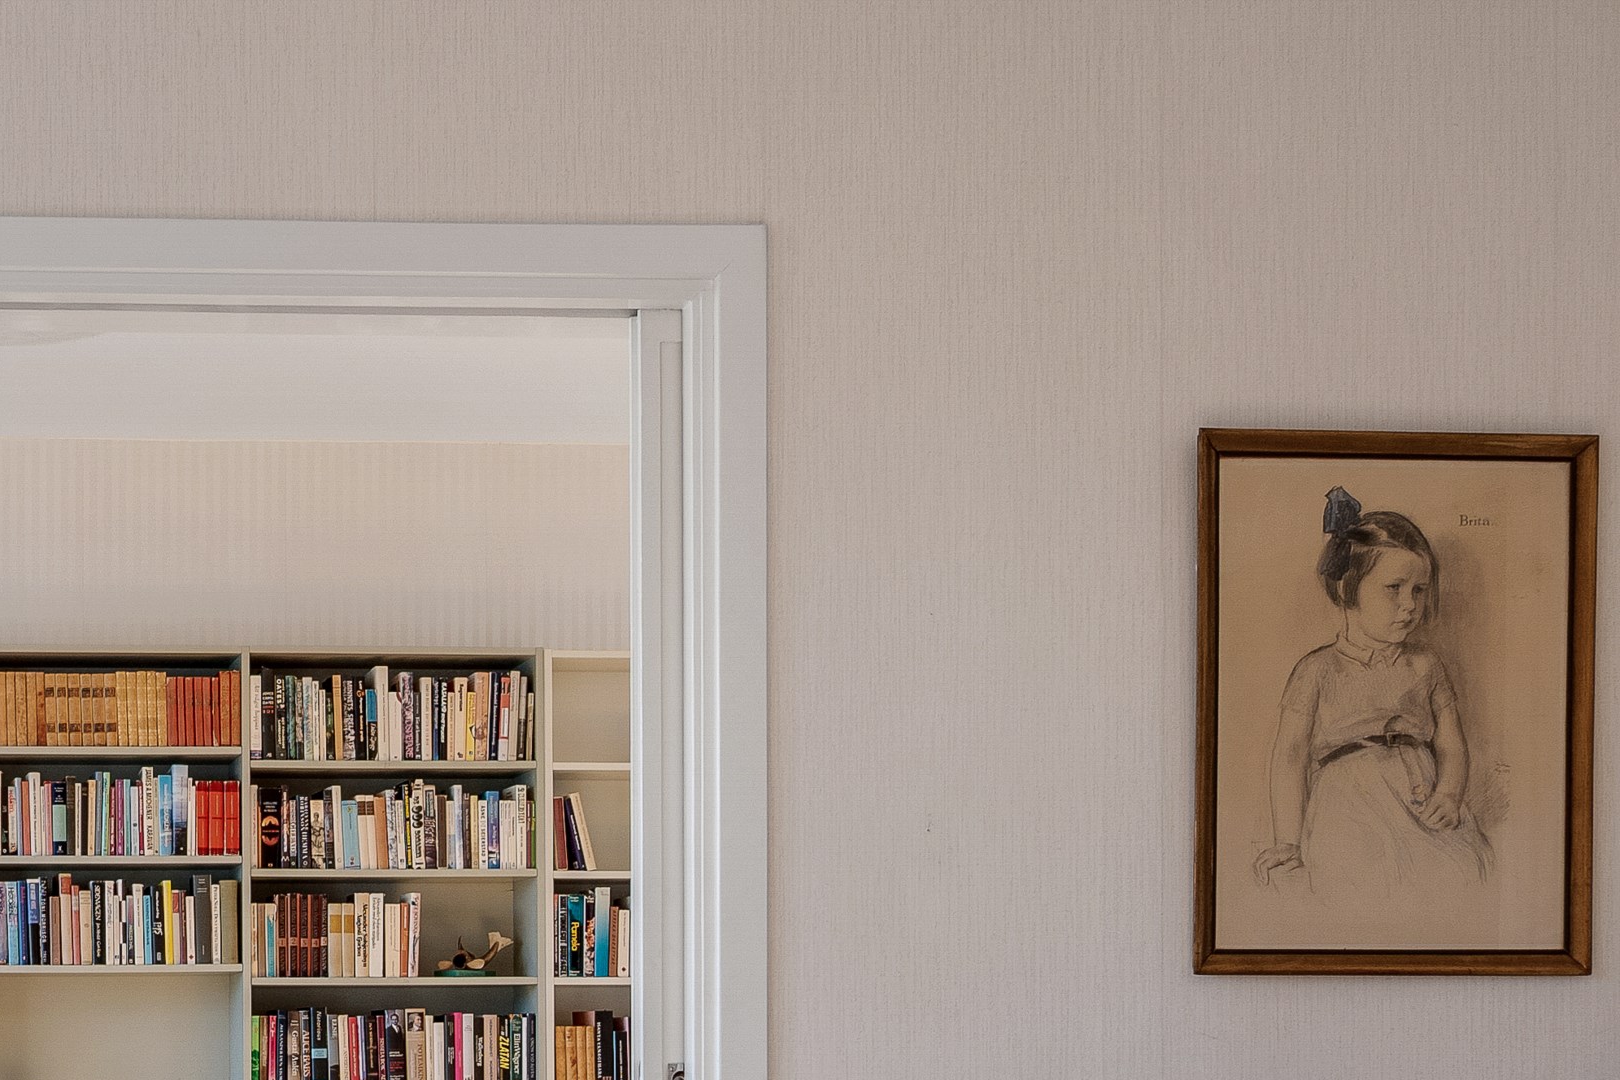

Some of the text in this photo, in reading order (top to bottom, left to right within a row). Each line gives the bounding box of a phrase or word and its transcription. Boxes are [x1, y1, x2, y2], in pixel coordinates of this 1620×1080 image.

[145, 793, 153, 821] MICHENER
[571, 921, 580, 952] Pamela
[291, 1030, 299, 1077] Gustaf Aulén
[302, 1029, 311, 1078] ALICE BABS
[499, 1035, 510, 1070] ZLATAN
[511, 1032, 521, 1075] Elin Wägner
